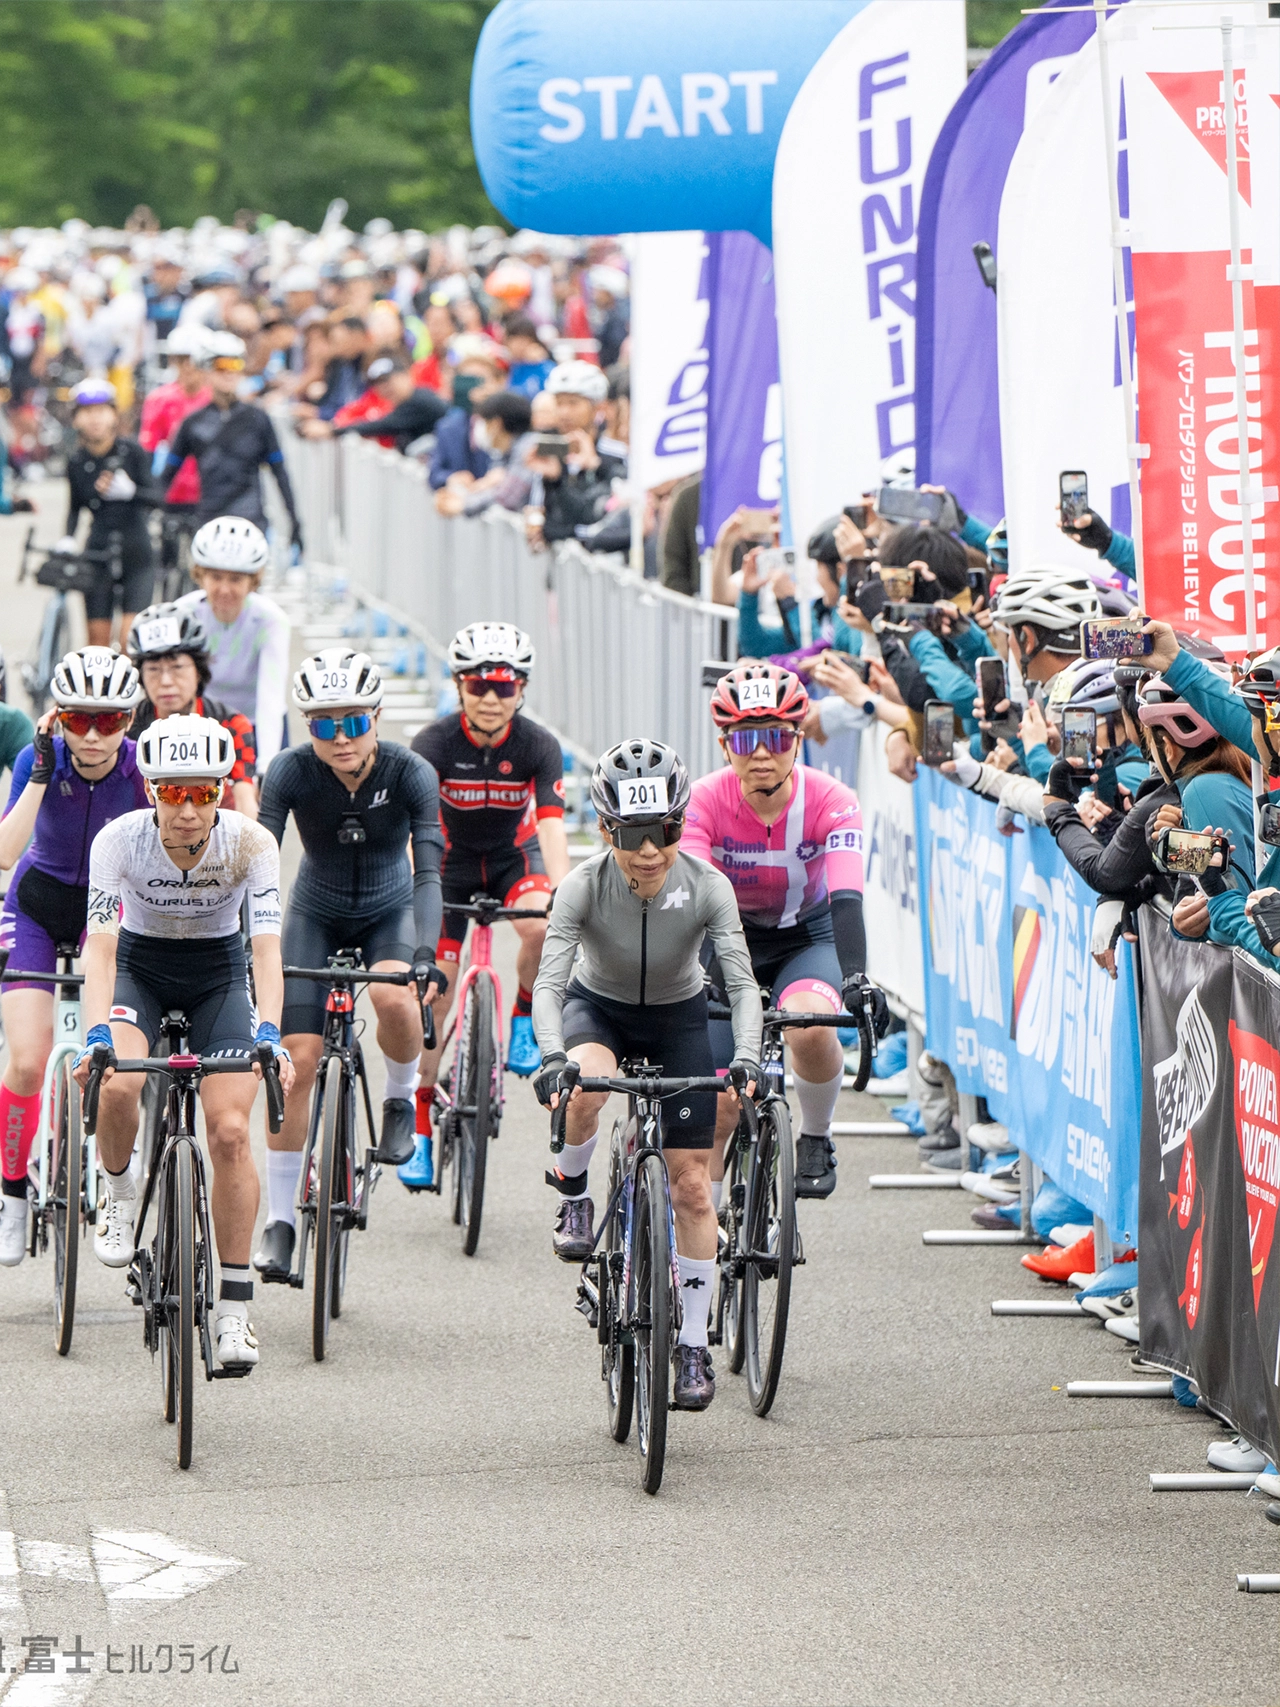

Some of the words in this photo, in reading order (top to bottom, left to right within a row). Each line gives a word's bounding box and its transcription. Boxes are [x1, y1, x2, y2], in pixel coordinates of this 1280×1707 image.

[538, 69, 778, 144] START
[1177, 349, 1197, 515] パワープロダクション
[1182, 522, 1199, 621] BELIEVE
[87, 655, 111, 669] 209
[322, 672, 348, 689] 203
[743, 684, 771, 700] 214
[170, 742, 198, 761] 204
[628, 785, 657, 805] 201
[723, 836, 766, 853] Climb
[723, 854, 757, 870] Over
[147, 878, 220, 888] ORBEA
[1239, 1058, 1278, 1126] POWER
